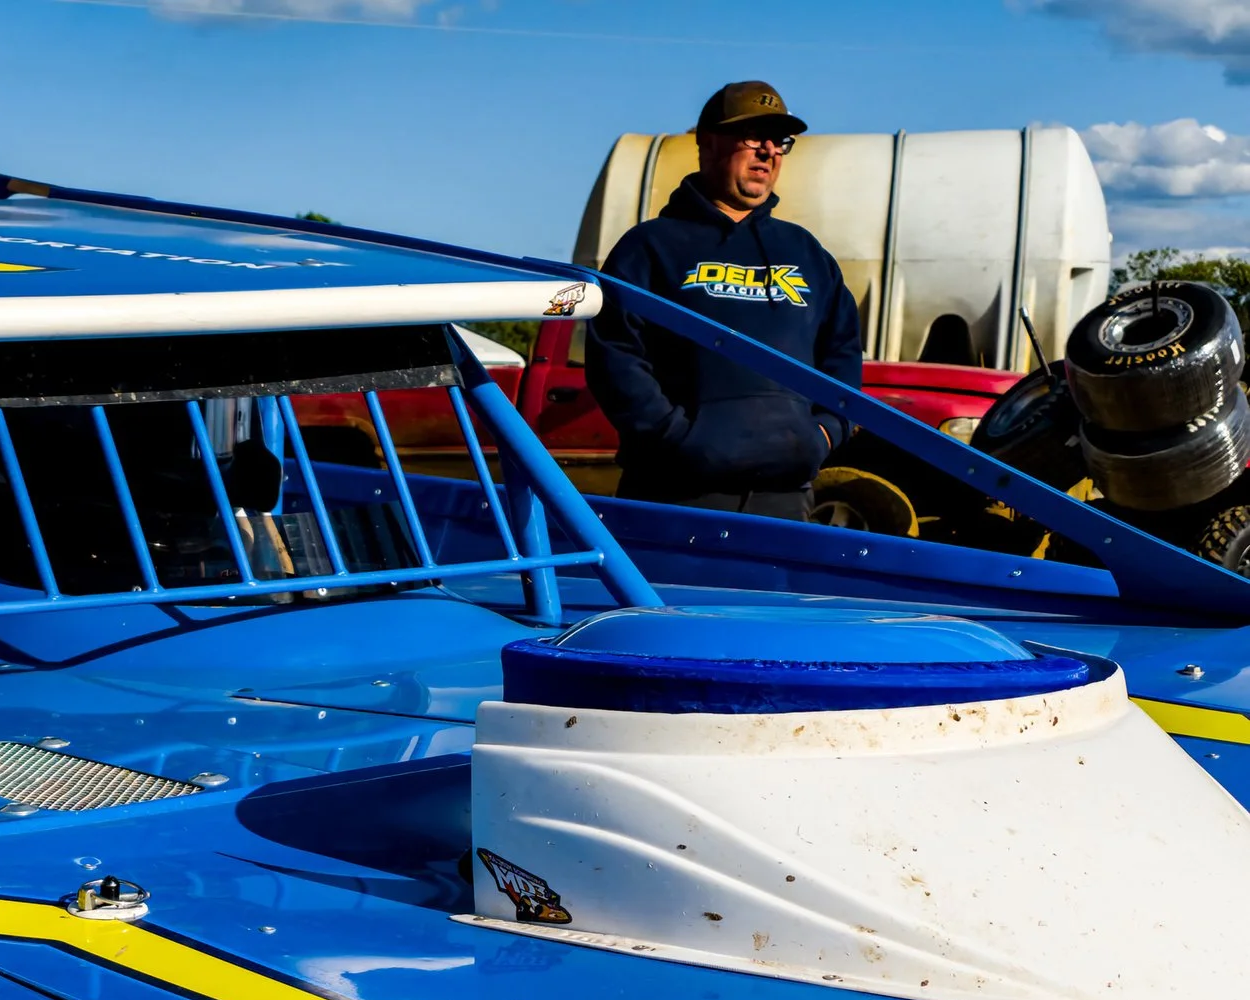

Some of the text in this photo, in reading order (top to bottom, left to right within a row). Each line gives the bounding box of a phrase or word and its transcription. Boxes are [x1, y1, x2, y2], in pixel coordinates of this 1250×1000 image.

[696, 262, 807, 306] DELK
[713, 283, 778, 297] RACING
[1105, 341, 1187, 368] Hoosier
[491, 862, 549, 901] MD3
